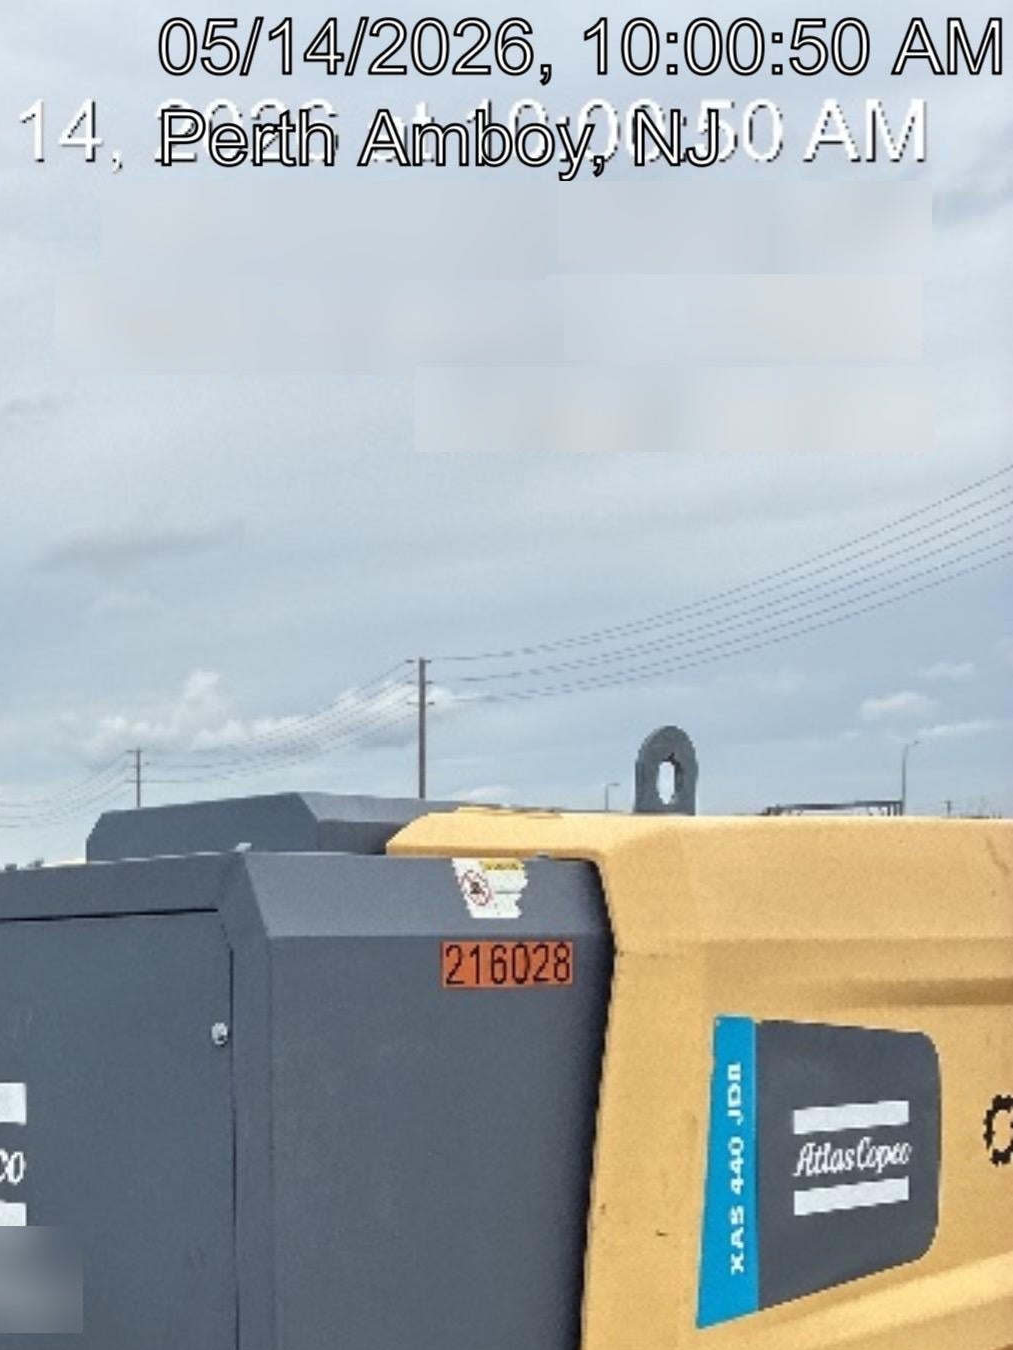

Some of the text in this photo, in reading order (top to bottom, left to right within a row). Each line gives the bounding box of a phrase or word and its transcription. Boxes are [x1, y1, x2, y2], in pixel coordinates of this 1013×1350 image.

[445, 942, 571, 985] 216028
[728, 1135, 745, 1195] 440
[792, 1142, 855, 1177] Atlas
[730, 1204, 745, 1276] XAS
